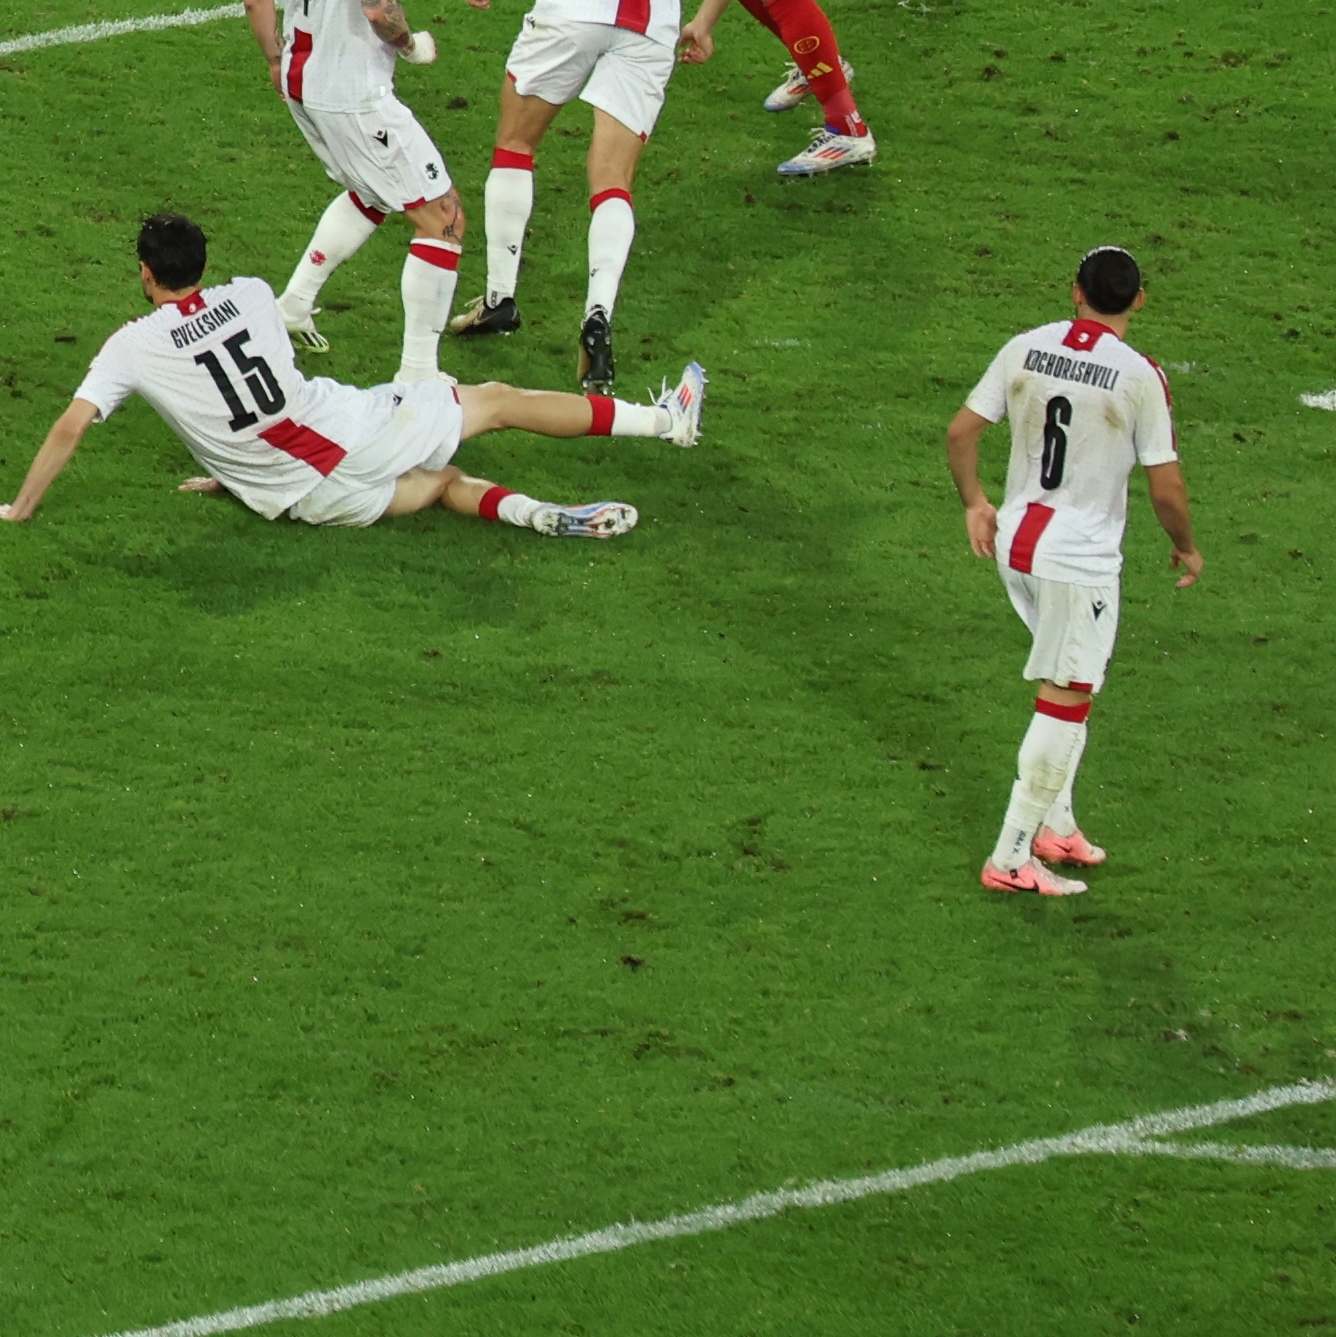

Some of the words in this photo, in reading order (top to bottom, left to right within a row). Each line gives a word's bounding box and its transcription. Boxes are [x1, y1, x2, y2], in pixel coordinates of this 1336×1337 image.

[170, 298, 241, 349] GVELESIANI
[193, 328, 286, 432] 15
[1040, 396, 1073, 491] 6
